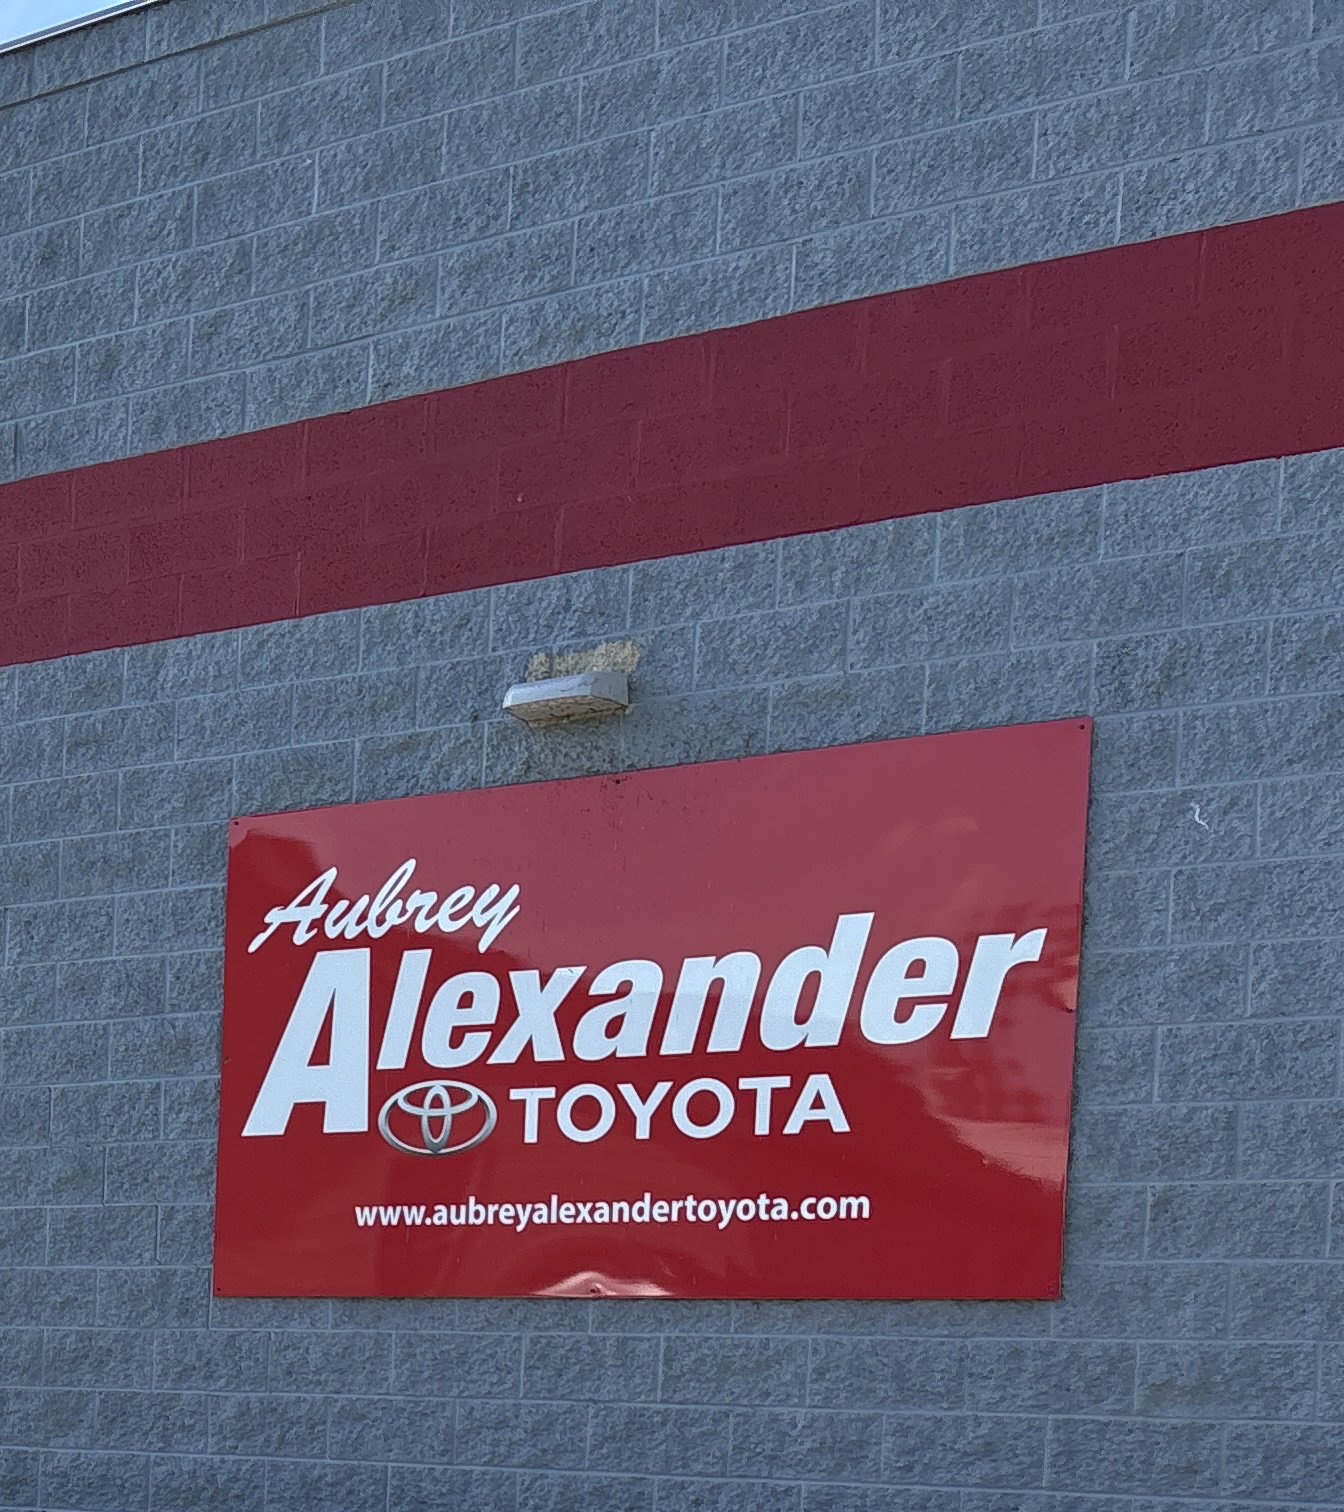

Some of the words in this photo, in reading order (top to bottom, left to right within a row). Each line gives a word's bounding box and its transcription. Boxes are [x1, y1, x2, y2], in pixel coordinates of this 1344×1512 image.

[248, 858, 520, 954] Aubrey
[241, 911, 1049, 1137] Alexander
[508, 1073, 852, 1144] TOYOTA
[354, 1192, 871, 1232] www.aubreyalexandertoyota.com
